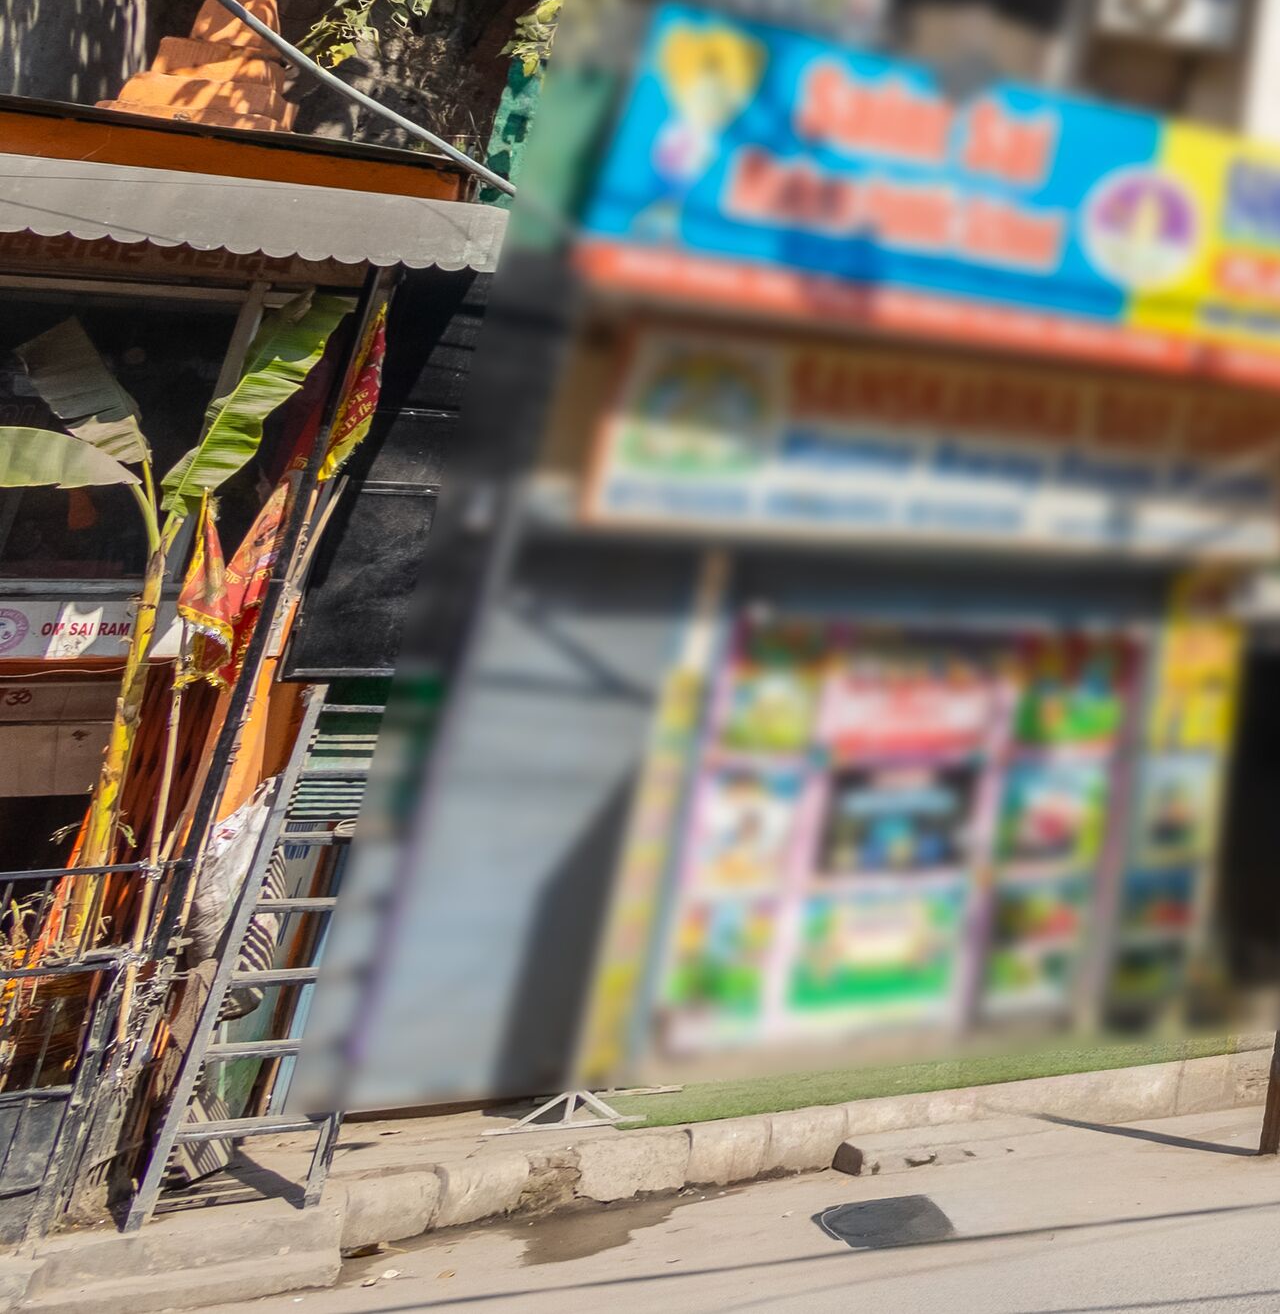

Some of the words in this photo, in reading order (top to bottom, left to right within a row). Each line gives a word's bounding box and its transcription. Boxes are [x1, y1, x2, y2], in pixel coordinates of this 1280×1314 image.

[41, 623, 65, 636] OM
[68, 623, 94, 636] SAI
[98, 622, 130, 636] RAM
